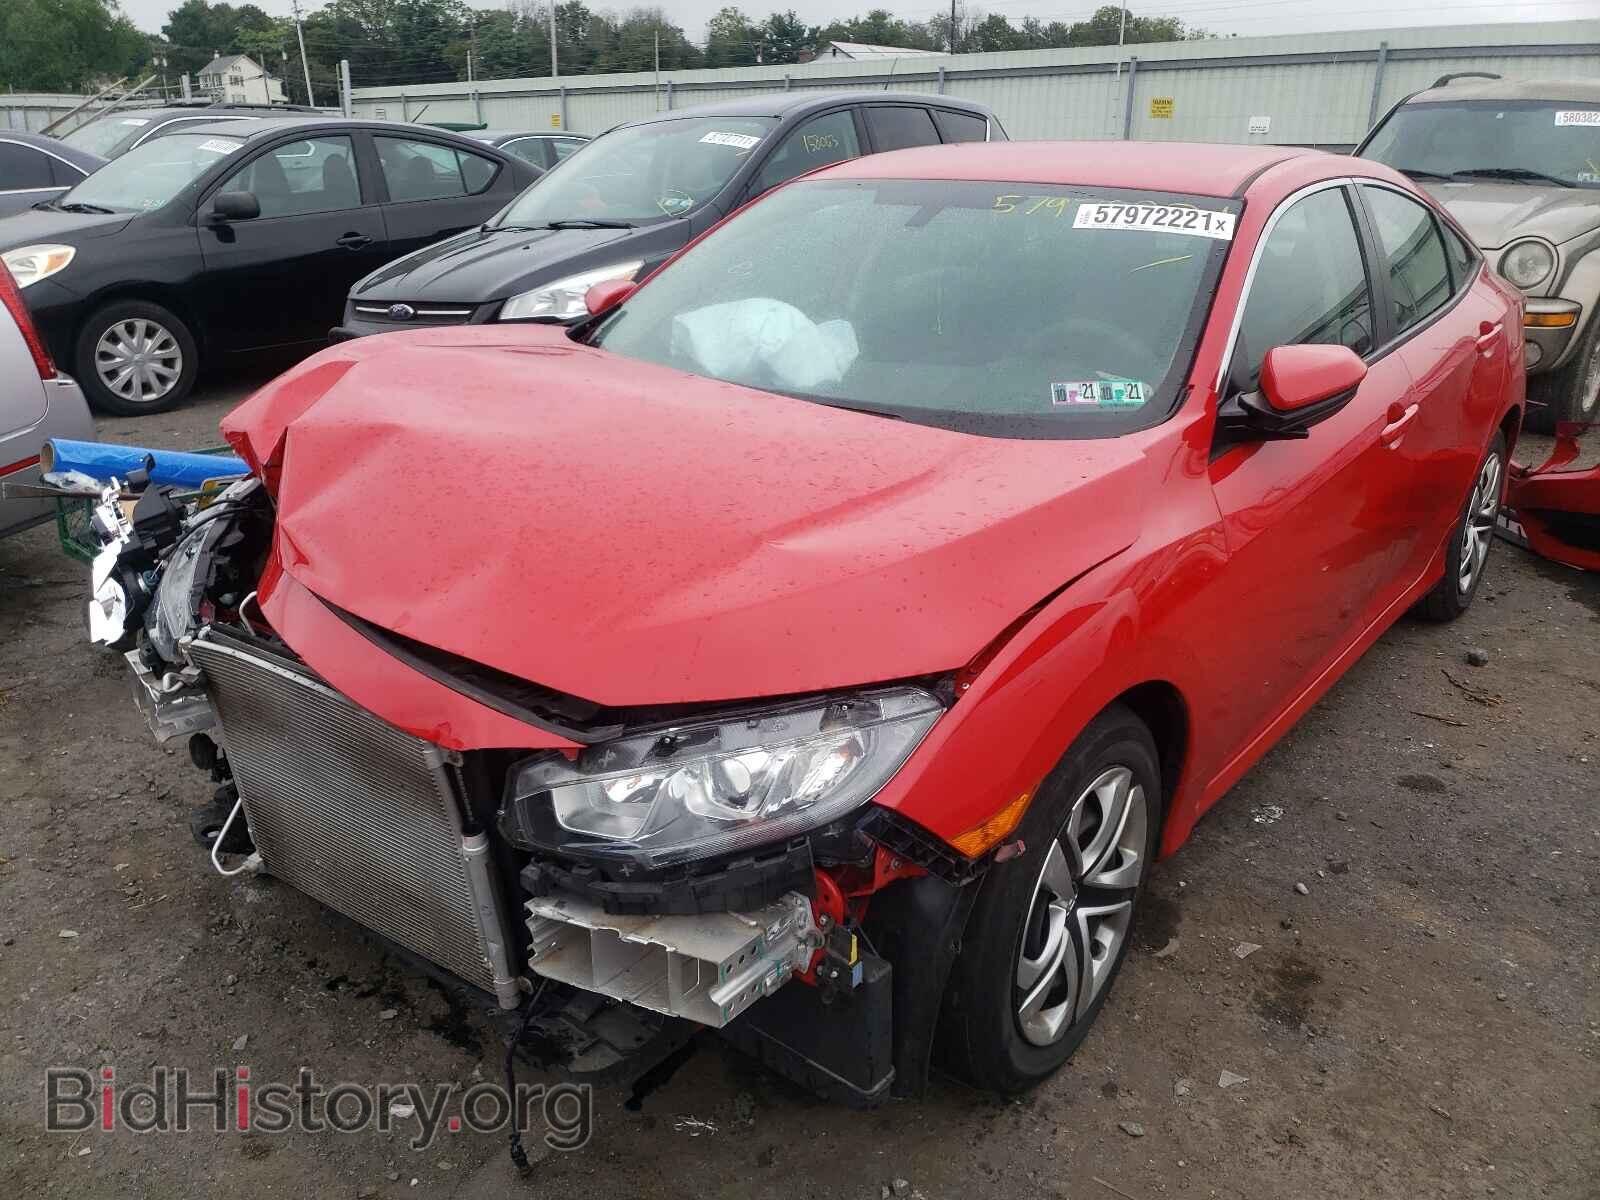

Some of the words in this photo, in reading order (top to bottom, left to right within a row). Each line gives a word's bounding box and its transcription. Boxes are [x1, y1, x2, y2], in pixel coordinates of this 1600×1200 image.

[1563, 112, 1600, 123] 580382
[1082, 383, 1096, 399] 21
[1127, 383, 1142, 399] 21
